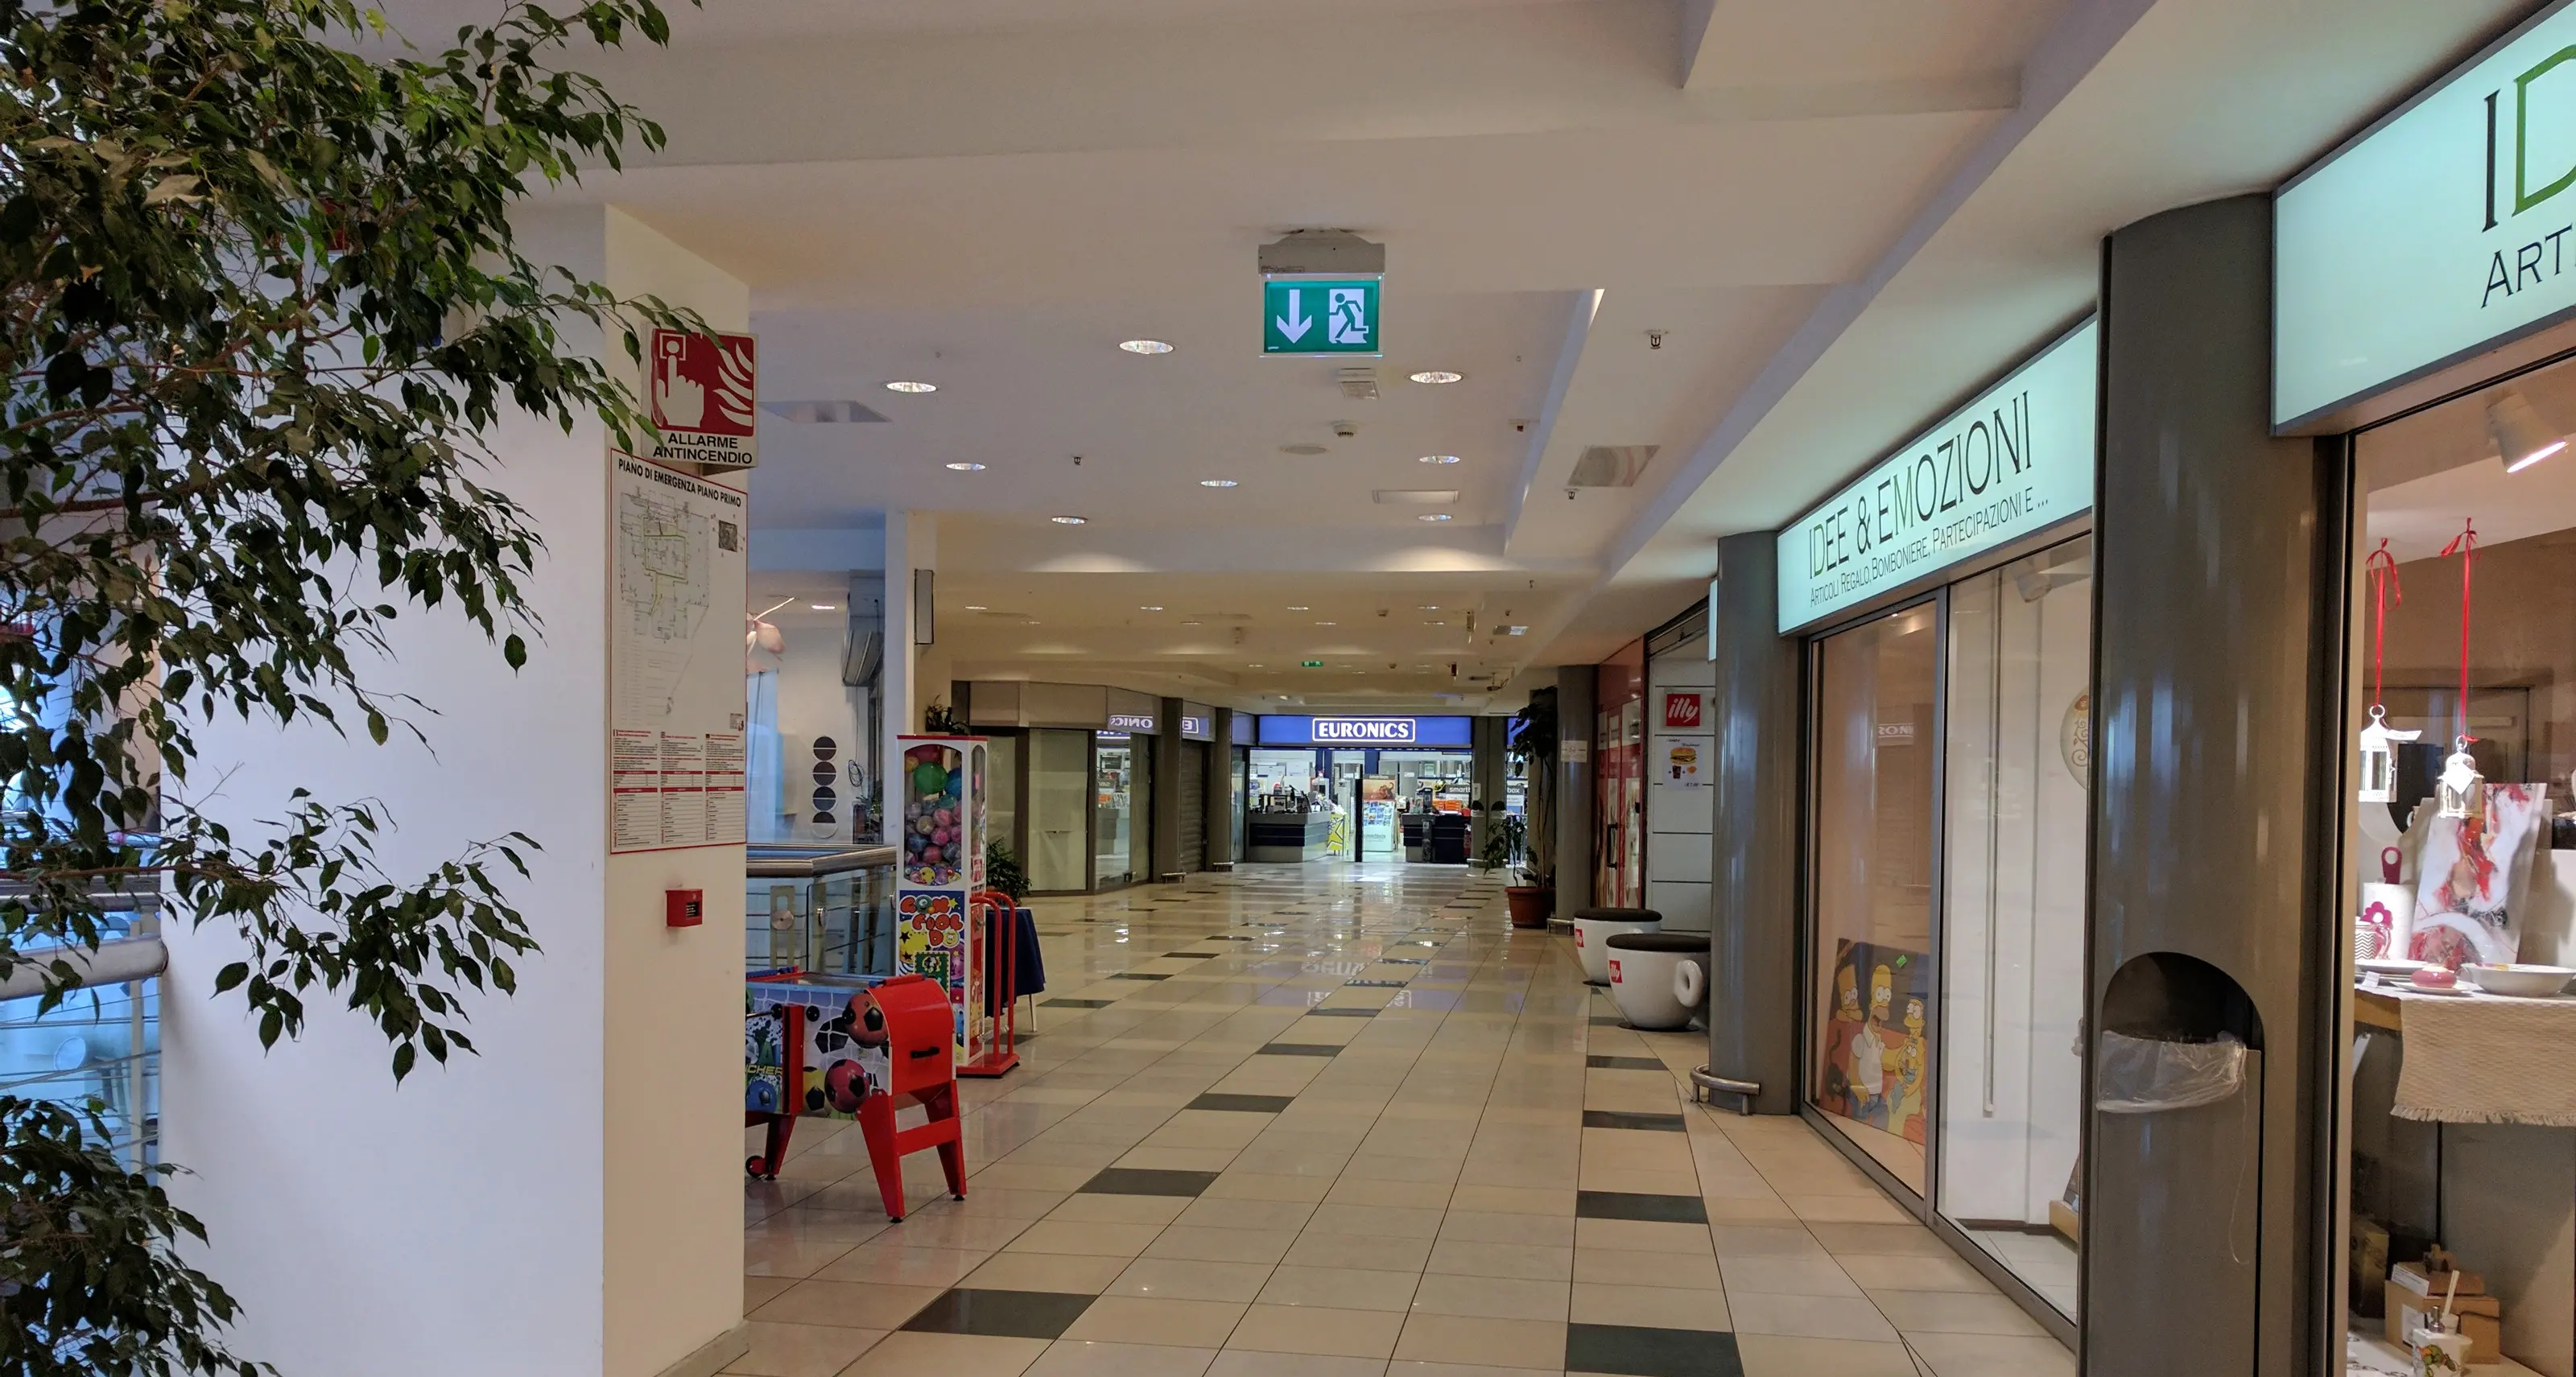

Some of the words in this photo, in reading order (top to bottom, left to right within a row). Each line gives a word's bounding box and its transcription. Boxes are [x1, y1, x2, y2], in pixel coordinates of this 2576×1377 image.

[2481, 223, 2576, 309] ART
[653, 446, 753, 464] ANTINCENDIO
[668, 433, 738, 449] ALLARME
[618, 458, 643, 476] PIANO
[645, 467, 653, 480] DI
[654, 471, 696, 496] EMERGENZA
[697, 484, 719, 501] PIANO
[720, 492, 741, 507] PRIMO
[1809, 504, 1850, 579] IDEE
[1856, 496, 1872, 555] &
[1877, 390, 2033, 545] EMOZIONI
[1810, 579, 1839, 608] ARTICOLI
[1840, 569, 1872, 594] REGALO,
[1872, 535, 1931, 579] BOMBONIERE,
[1933, 495, 2022, 554] PARTECIPAZIONI
[2025, 486, 2034, 513] E
[1668, 697, 1699, 724] illy
[1319, 722, 1409, 738] EURONICS
